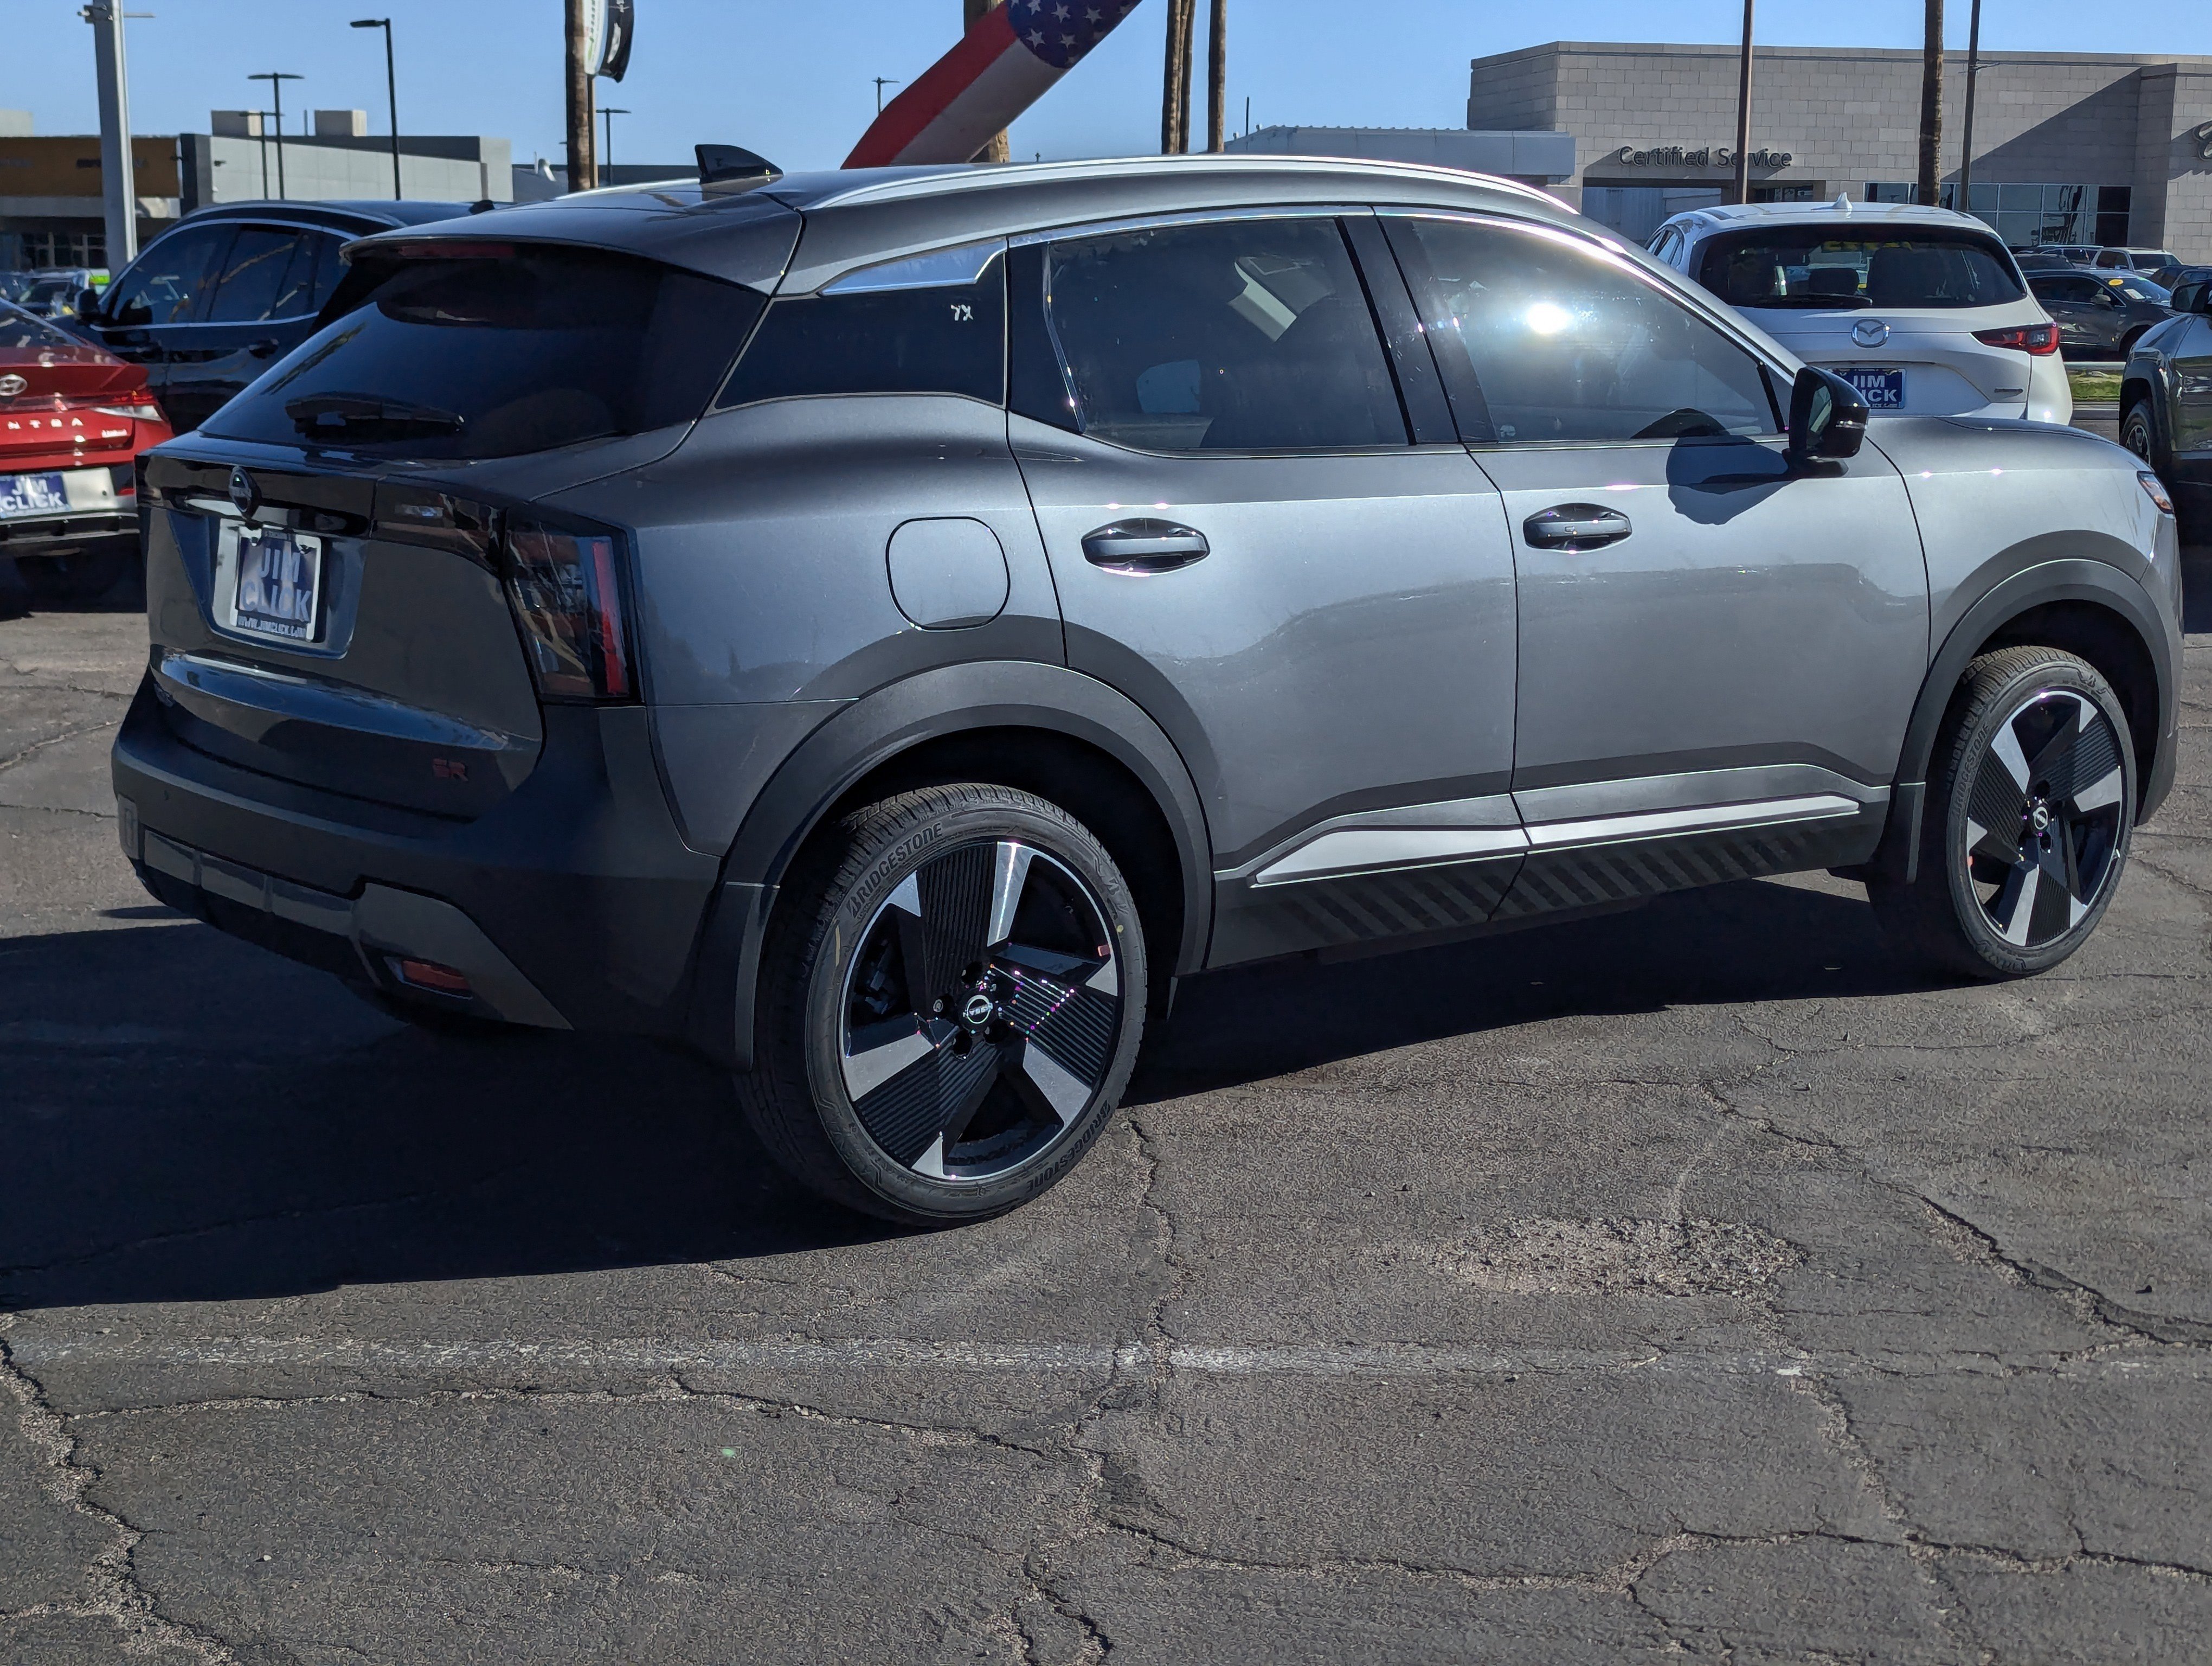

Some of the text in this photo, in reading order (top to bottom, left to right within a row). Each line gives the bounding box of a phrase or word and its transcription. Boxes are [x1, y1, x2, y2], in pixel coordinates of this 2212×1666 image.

[1619, 145, 1792, 167] Certified Sevice
[1861, 389, 1898, 402] ICK
[11, 477, 48, 496] JIM
[1, 491, 65, 511] CLICK
[259, 547, 301, 582] JIM
[242, 579, 312, 622] CLICK
[846, 823, 943, 919] BRIDGESTONE
[1026, 1099, 1111, 1193] BRIDGESTONE
